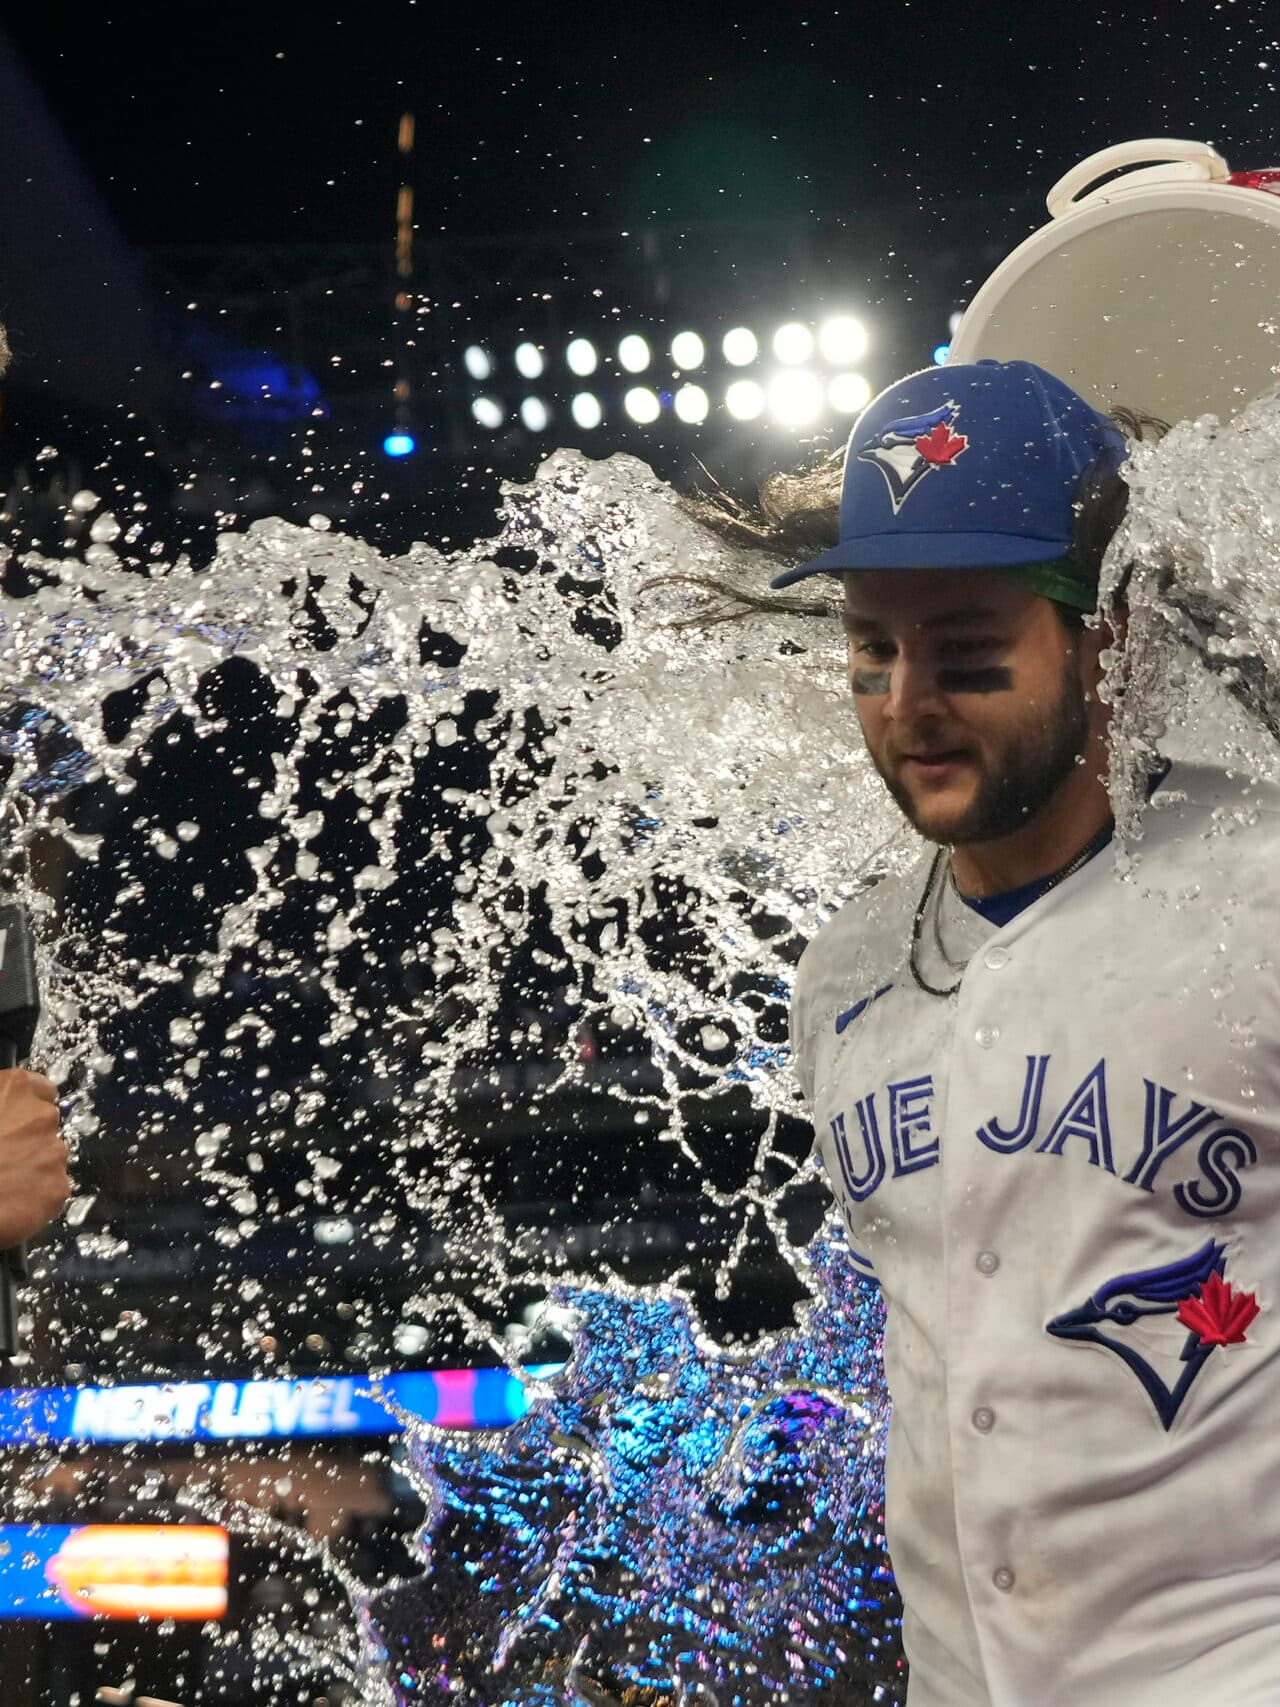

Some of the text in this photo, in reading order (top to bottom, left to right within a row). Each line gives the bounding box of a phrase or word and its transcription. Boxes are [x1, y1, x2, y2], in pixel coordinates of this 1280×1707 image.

[830, 1053, 1257, 1218] UE JAYS
[71, 1380, 359, 1440] NEXT LEVEL
